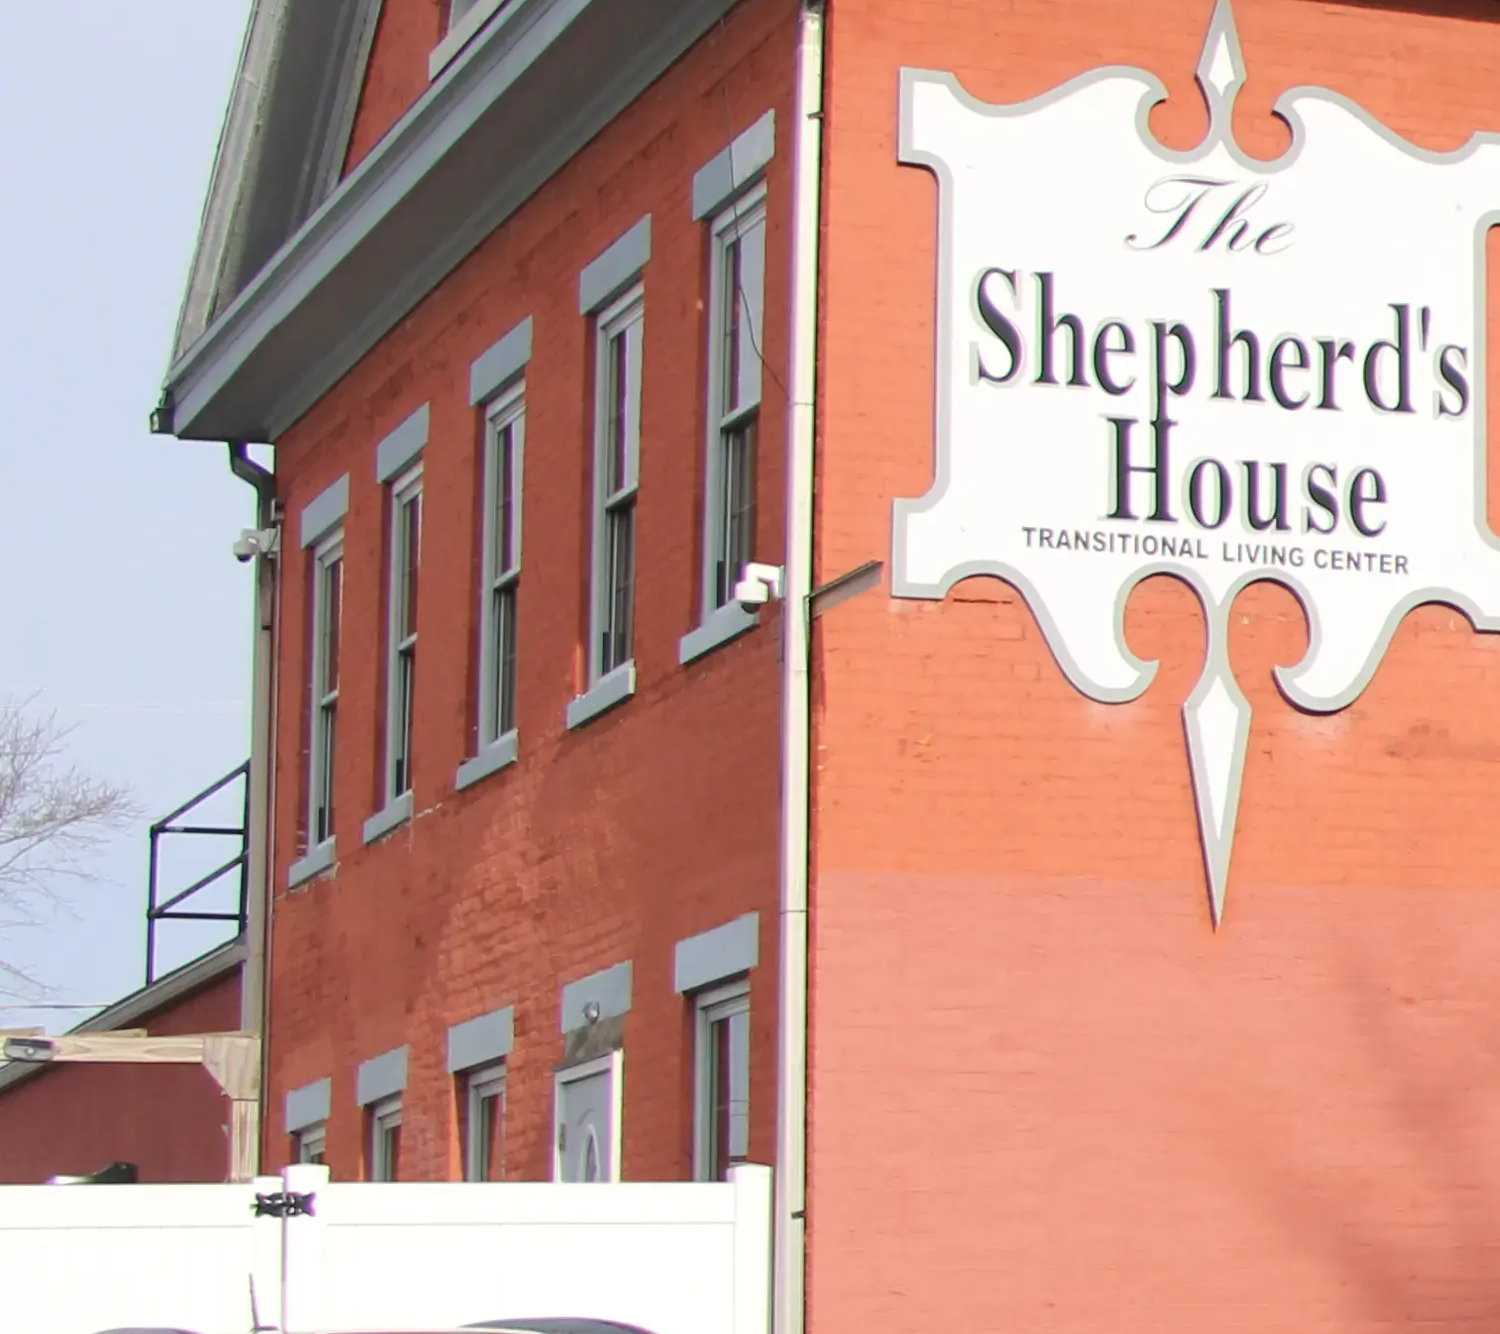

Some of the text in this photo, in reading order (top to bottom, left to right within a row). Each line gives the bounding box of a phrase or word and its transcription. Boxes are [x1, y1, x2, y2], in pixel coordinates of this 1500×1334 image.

[1123, 174, 1297, 256] The
[971, 266, 1471, 426] Shepherd's
[1102, 415, 1390, 539] House
[1022, 526, 1410, 575] TRANSITIONAL LIVING CENTER
